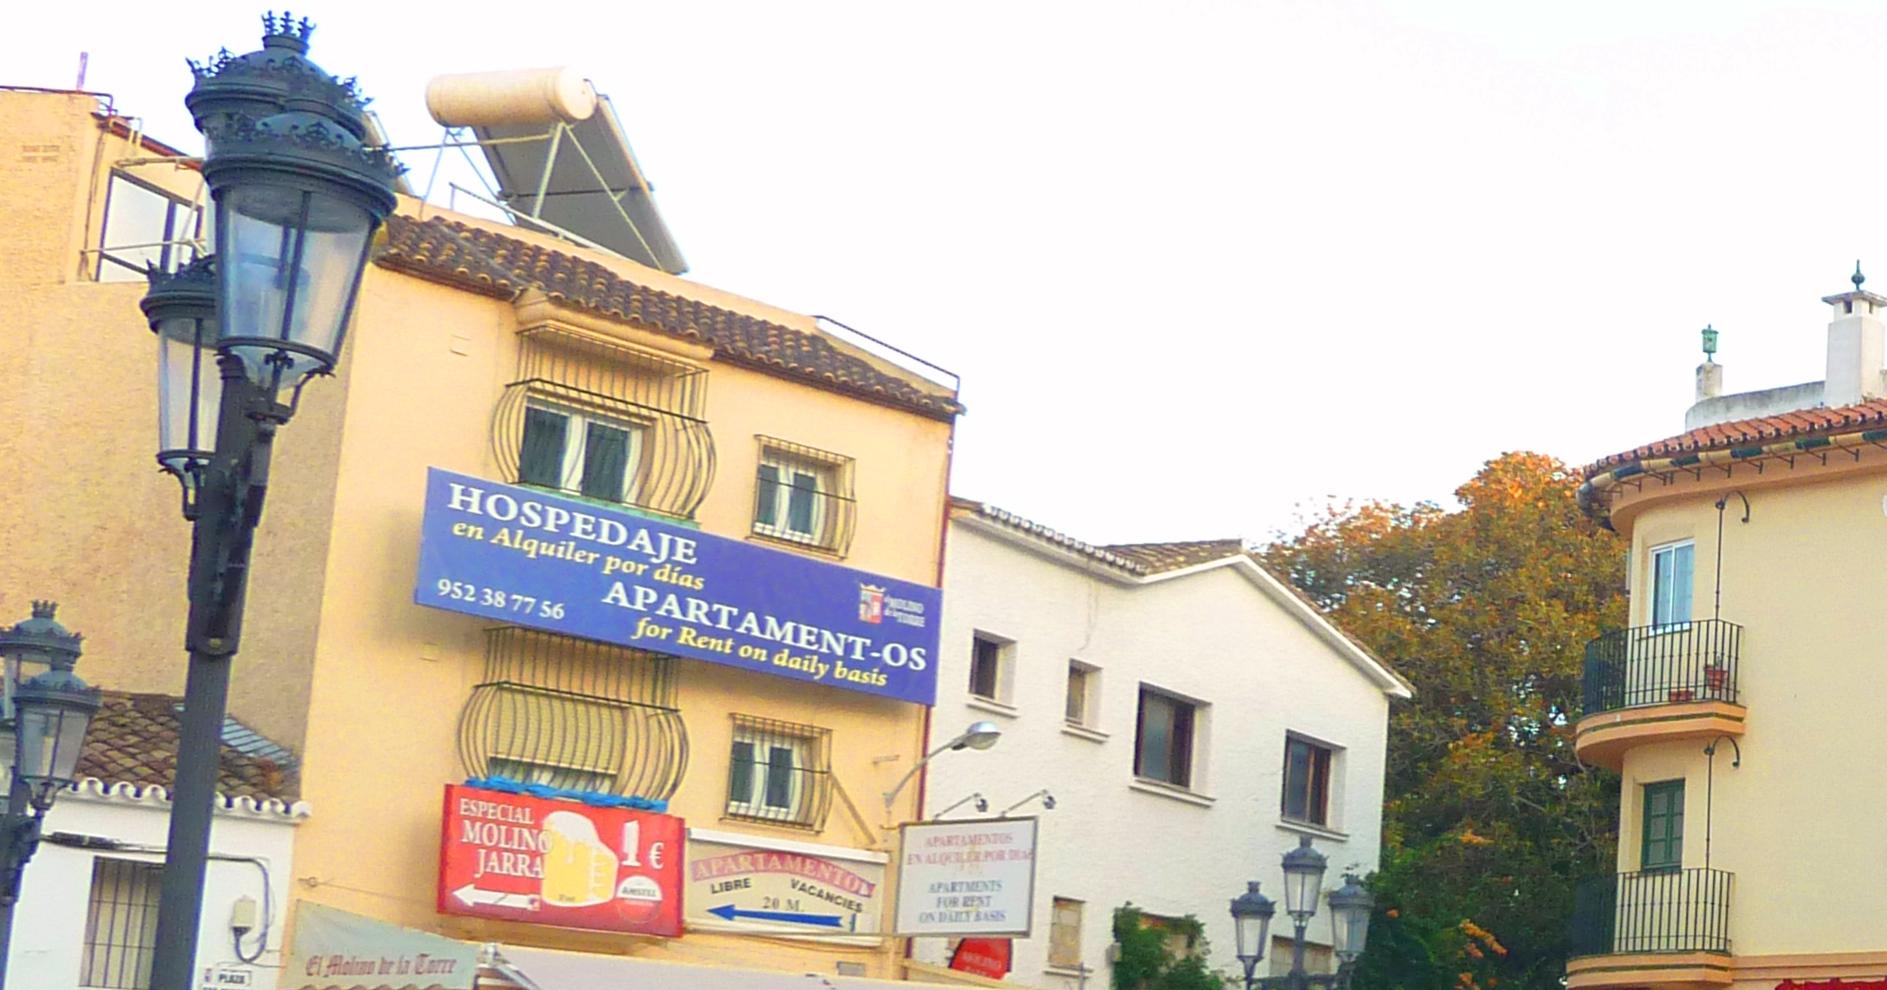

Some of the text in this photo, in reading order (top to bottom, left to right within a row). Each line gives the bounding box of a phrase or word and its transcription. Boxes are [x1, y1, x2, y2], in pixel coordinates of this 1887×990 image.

[448, 483, 698, 564] HOSPEDAJE
[453, 521, 705, 590] en Alquiler por días
[437, 579, 565, 620] 952 38 77 56
[602, 581, 927, 671] APARTAMENT-OS
[631, 617, 888, 686] for Rent on daily basis
[460, 798, 534, 824] ESPECIAL
[461, 819, 552, 853] MOLINO
[621, 820, 664, 869] 1 €
[925, 832, 1014, 847] APARTAMENTOS
[475, 849, 545, 879] JARRA
[907, 853, 923, 865] EN
[925, 851, 981, 866] ALQUILER
[984, 851, 1006, 862] POR
[694, 853, 874, 897] APARTAMENTO
[928, 880, 1003, 893] APARTMENTS
[622, 886, 657, 897] AMSTEL
[710, 878, 863, 913] LIBRE VACANCIES
[763, 896, 780, 909] 20
[936, 896, 992, 908] FOR RENT
[919, 910, 1007, 923] ON DAILY BASIS
[306, 955, 323, 976] El
[378, 956, 395, 975] de
[397, 956, 411, 975] la
[415, 953, 457, 975] Torre
[219, 974, 245, 984] PLAZA
